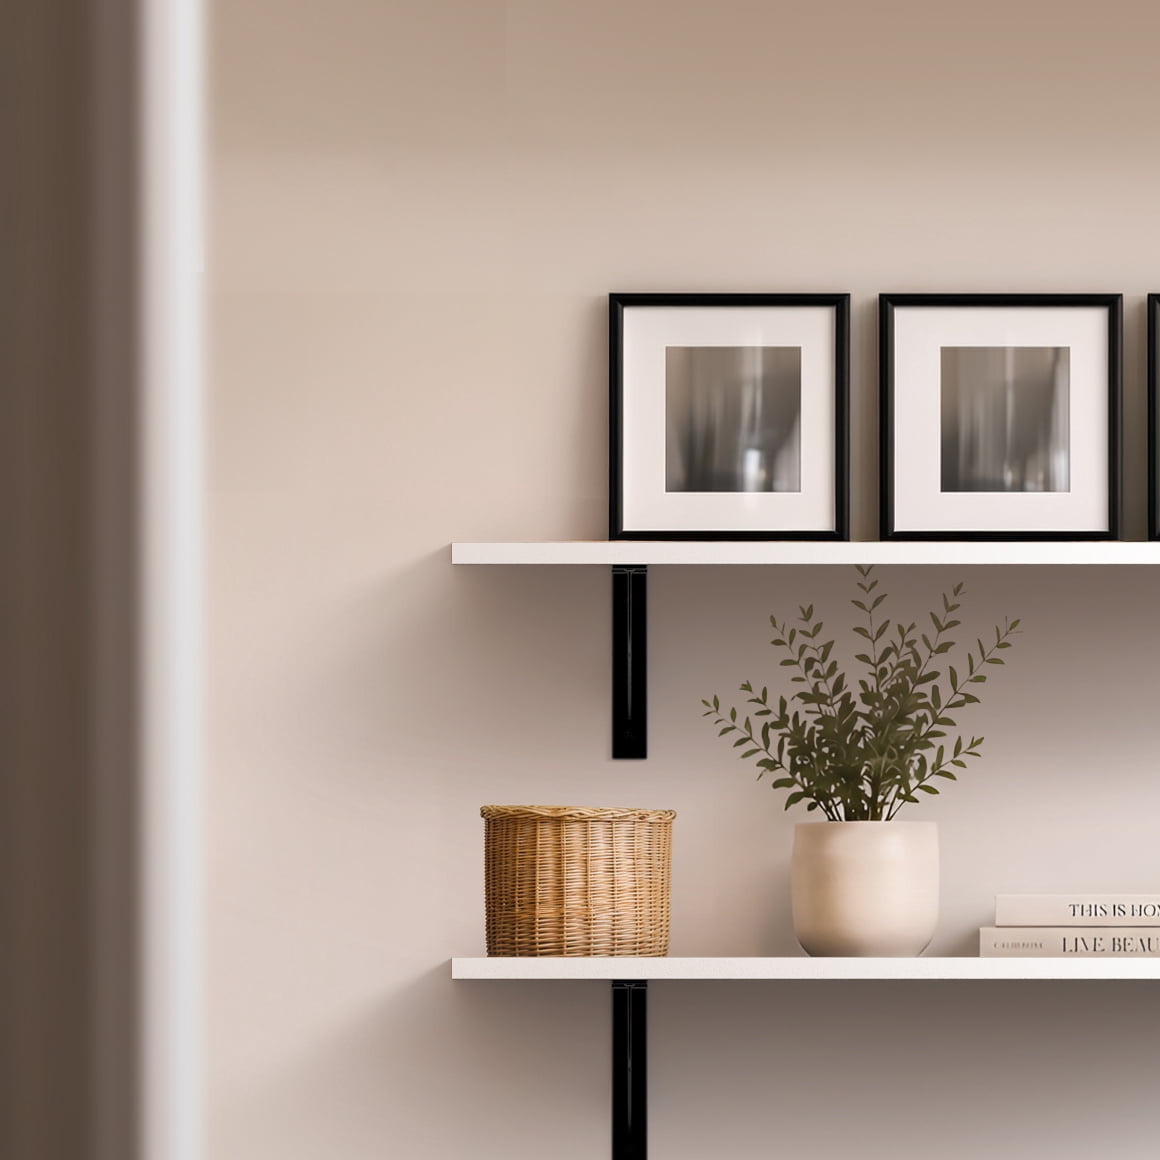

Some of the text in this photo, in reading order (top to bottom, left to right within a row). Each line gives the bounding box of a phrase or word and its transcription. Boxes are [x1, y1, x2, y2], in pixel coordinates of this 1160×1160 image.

[1068, 903, 1108, 917] THIS
[1111, 903, 1126, 917] IS
[1062, 936, 1105, 952] LIVE
